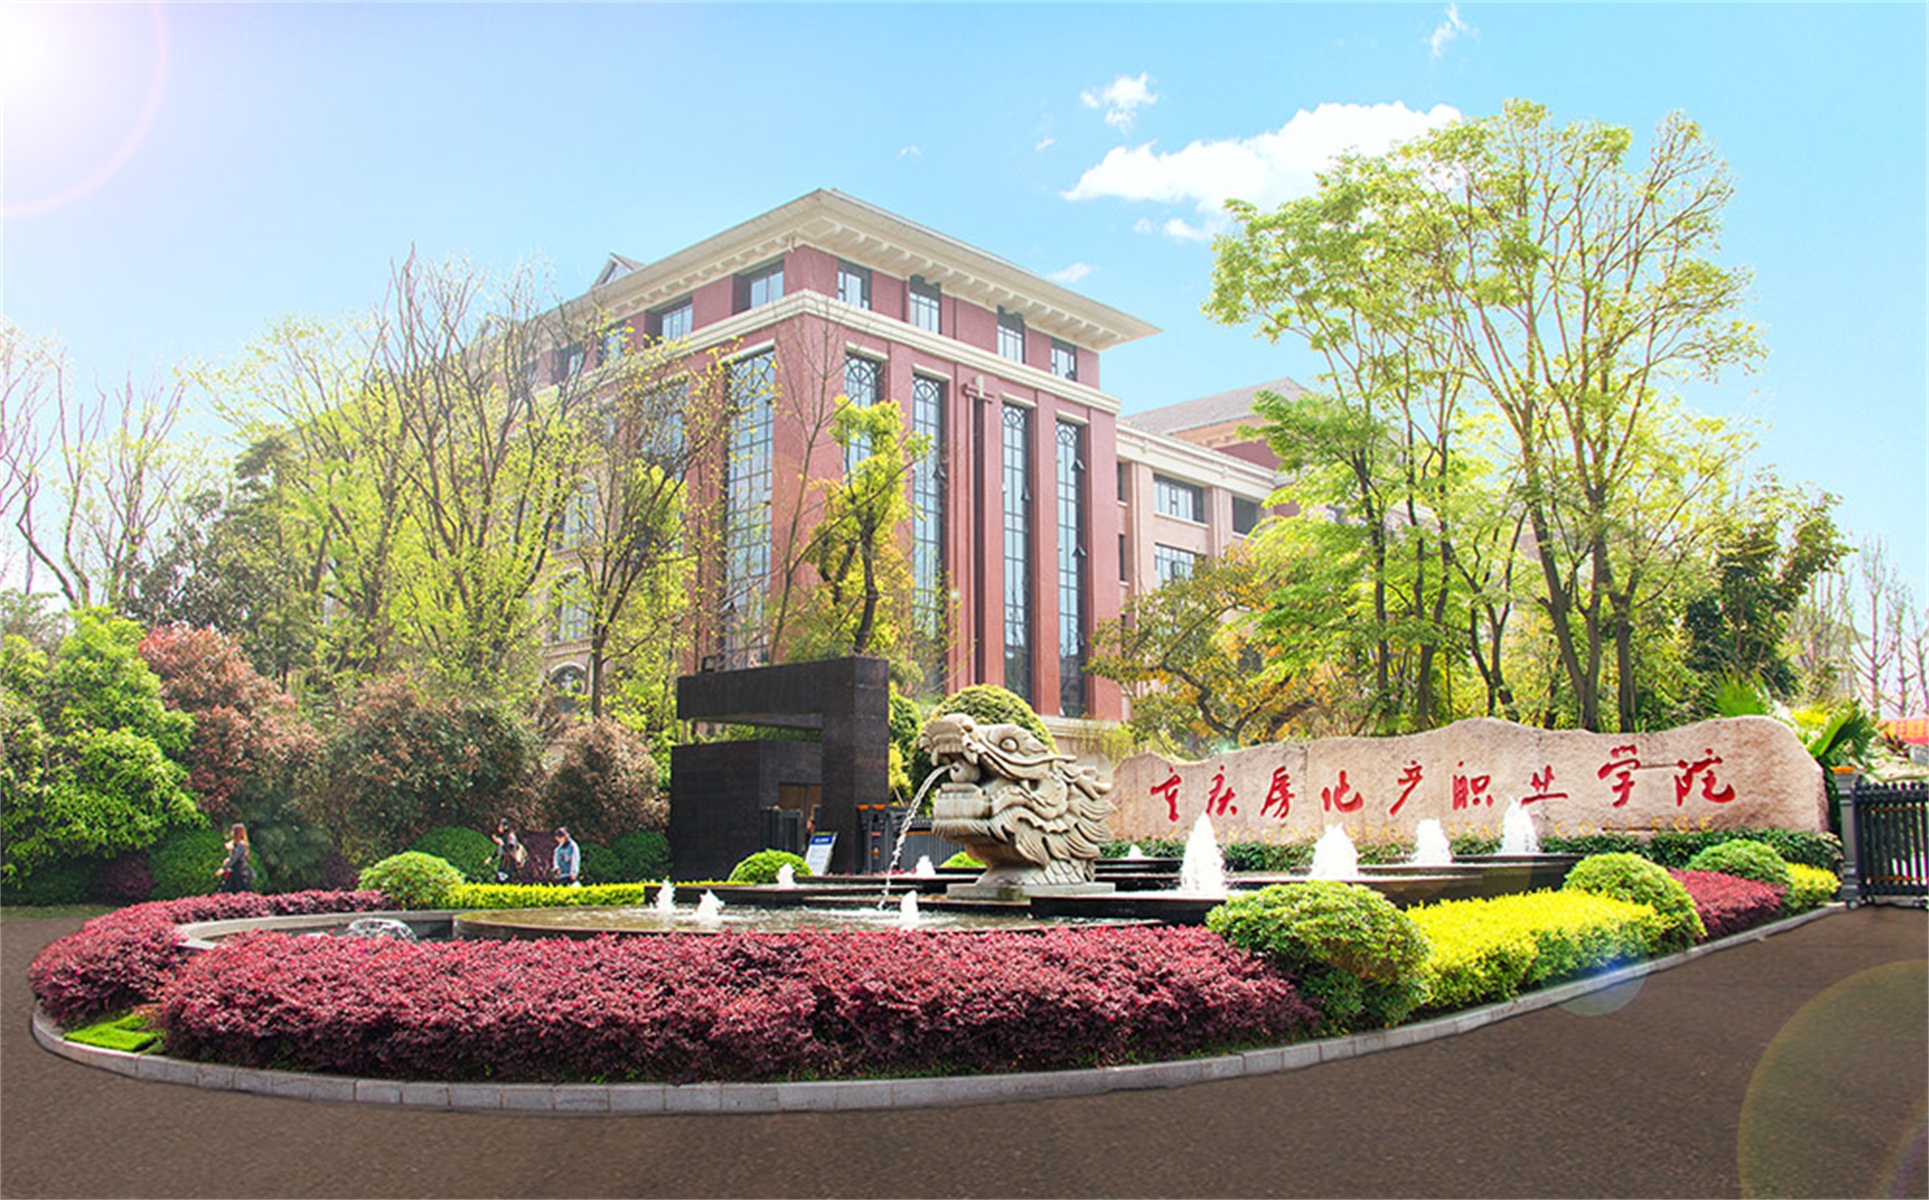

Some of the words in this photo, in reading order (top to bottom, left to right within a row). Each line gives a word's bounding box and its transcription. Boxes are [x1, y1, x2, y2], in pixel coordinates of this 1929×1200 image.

[1150, 744, 1735, 822] 重庆房地产职业学院
[1167, 825, 1319, 845] CNGQING
[1554, 815, 1714, 836] COLLEGE
